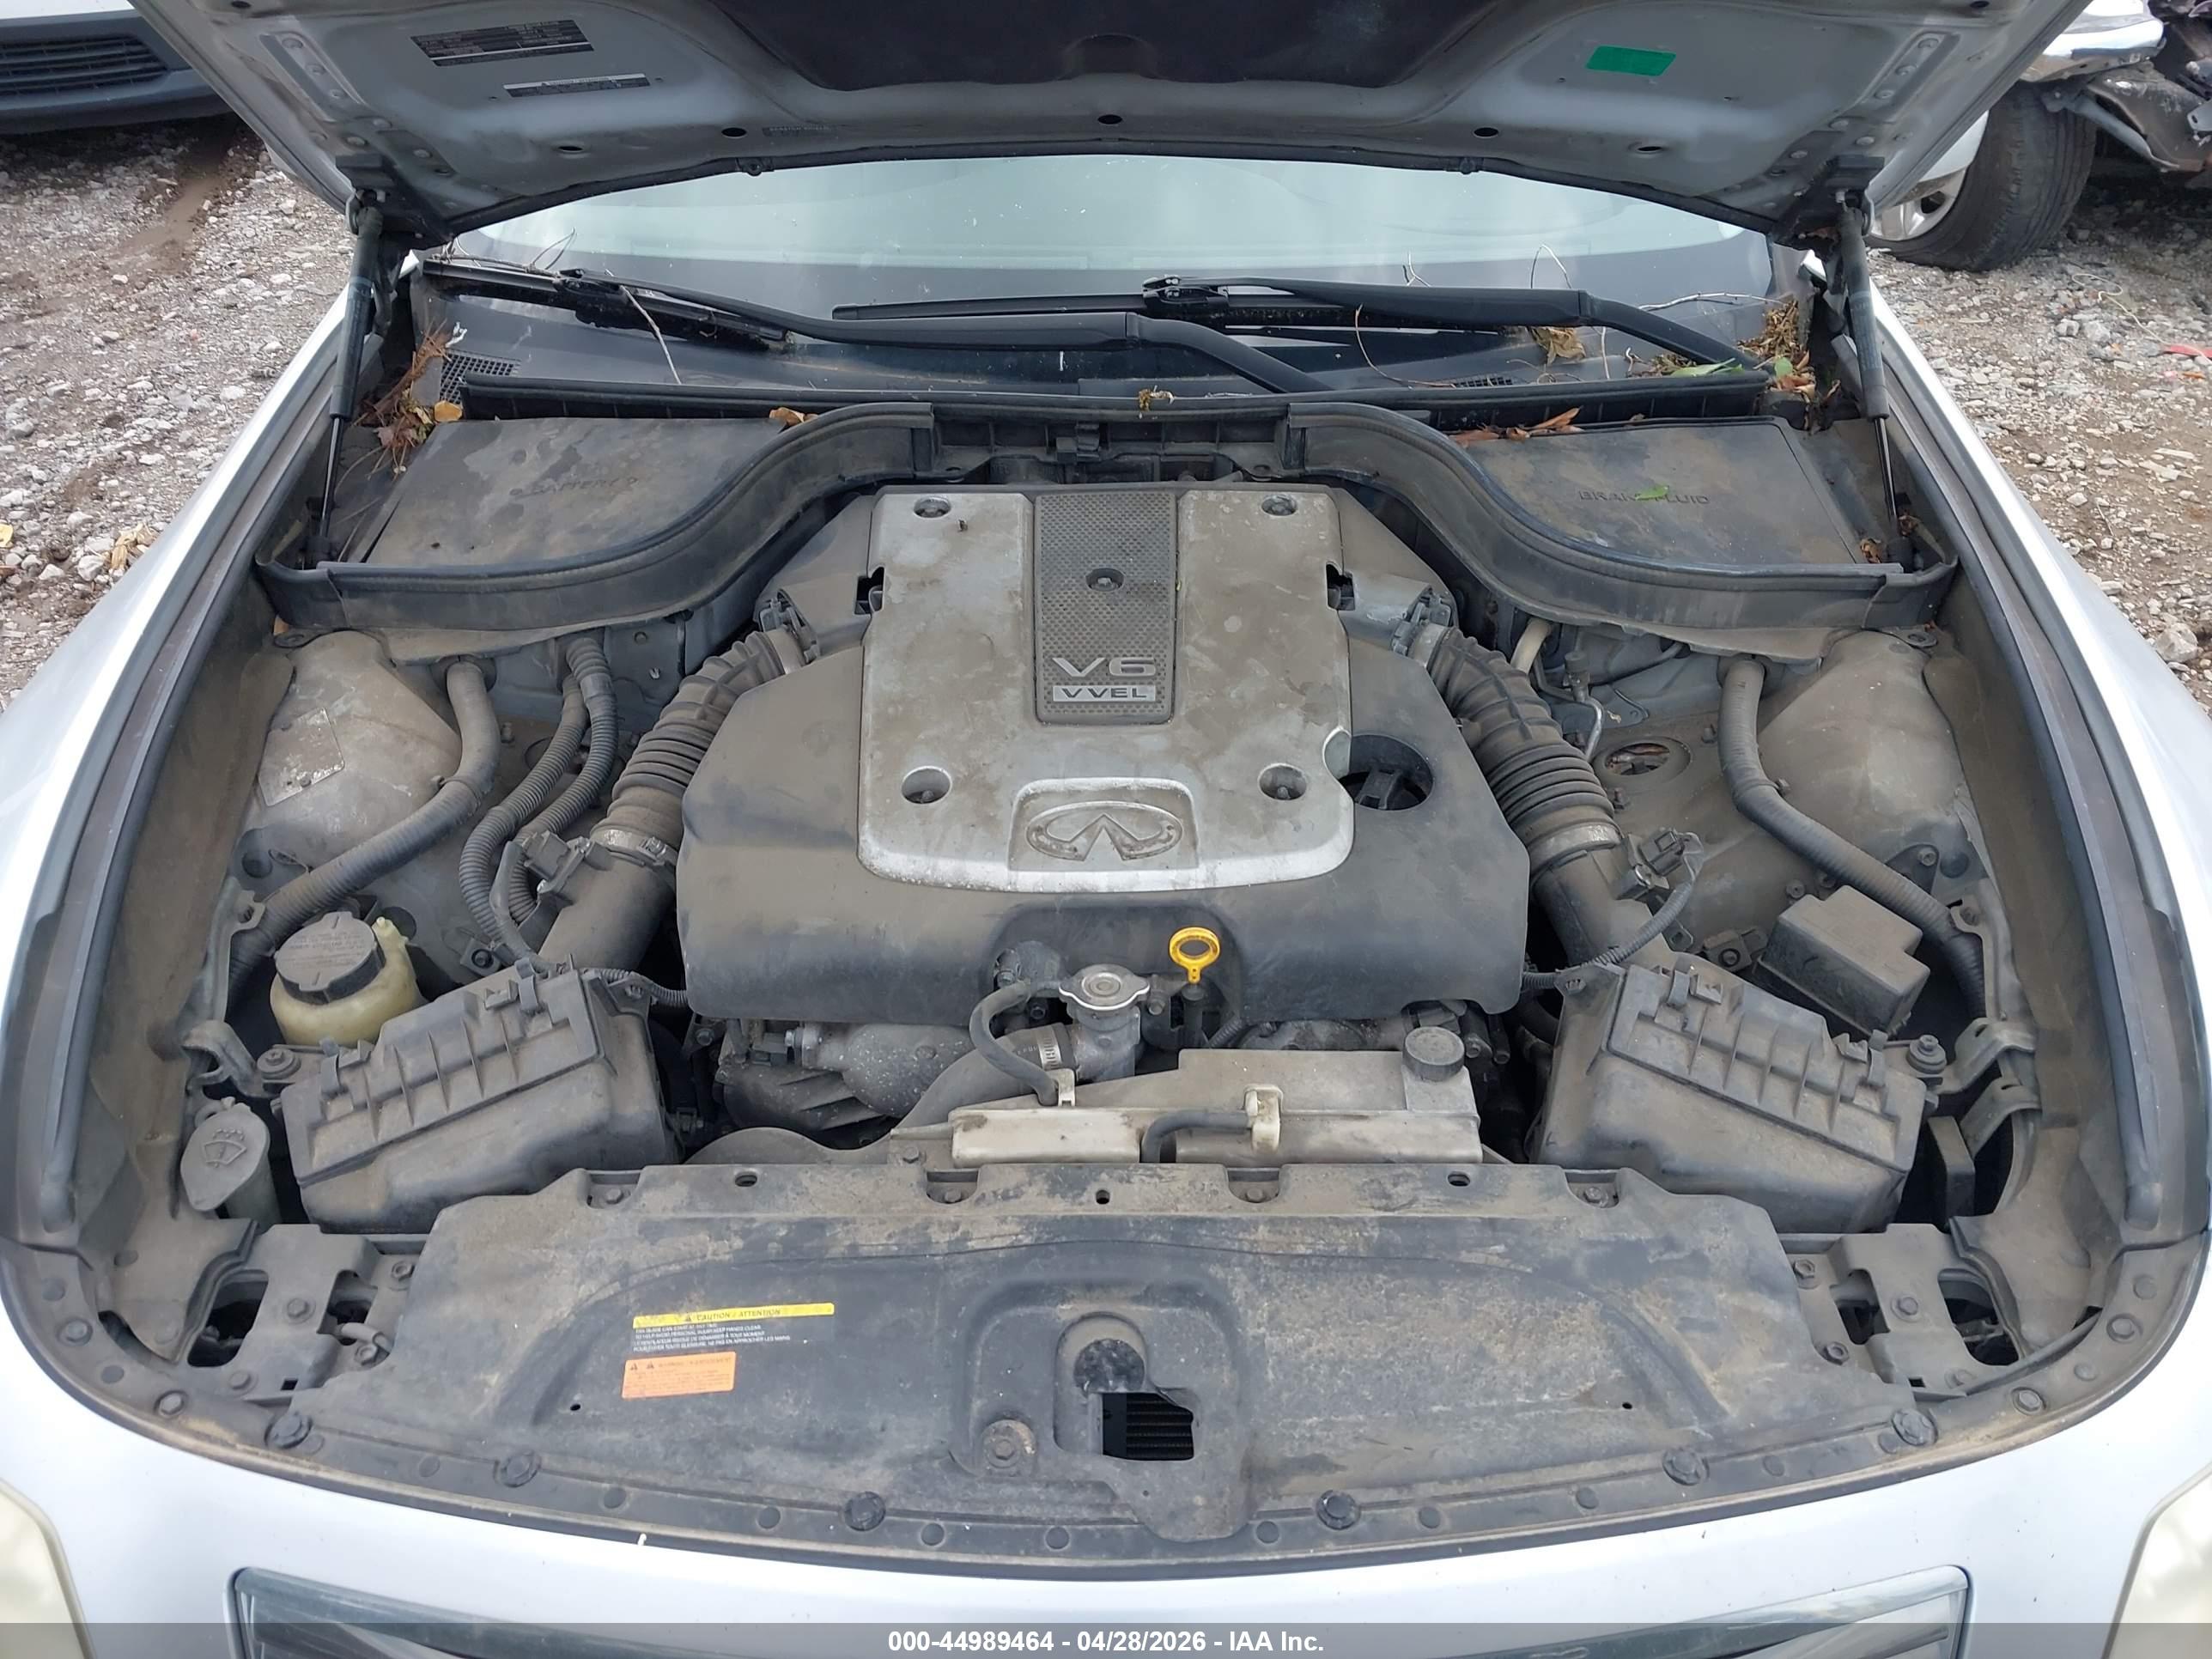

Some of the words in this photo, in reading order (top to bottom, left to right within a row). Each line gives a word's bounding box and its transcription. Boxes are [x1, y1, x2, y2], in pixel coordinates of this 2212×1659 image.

[1578, 490, 1644, 502] BRAK
[1052, 657, 1156, 678] V6
[1060, 687, 1147, 699] VVEL
[696, 1311, 731, 1321] CAUTION
[740, 1309, 781, 1317] ATTENTION
